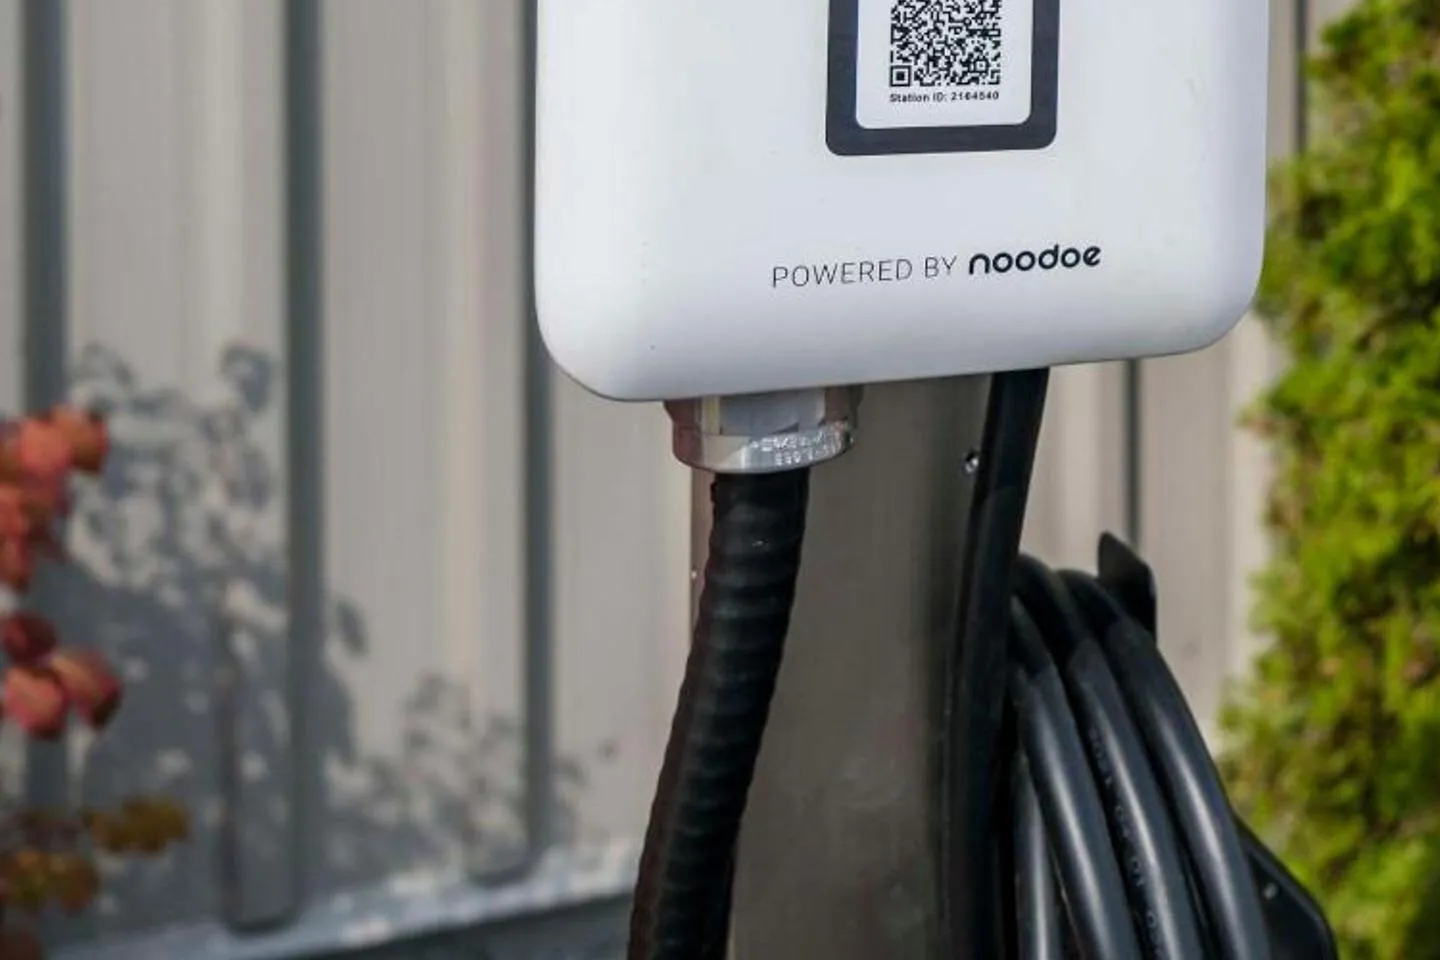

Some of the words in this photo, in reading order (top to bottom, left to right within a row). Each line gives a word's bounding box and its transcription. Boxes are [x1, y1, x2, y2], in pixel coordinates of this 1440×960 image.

[889, 92, 930, 102] Station
[932, 91, 947, 102] ID:
[771, 257, 913, 289] POWERED
[923, 254, 958, 280] BY
[967, 243, 1101, 276] noodoe
